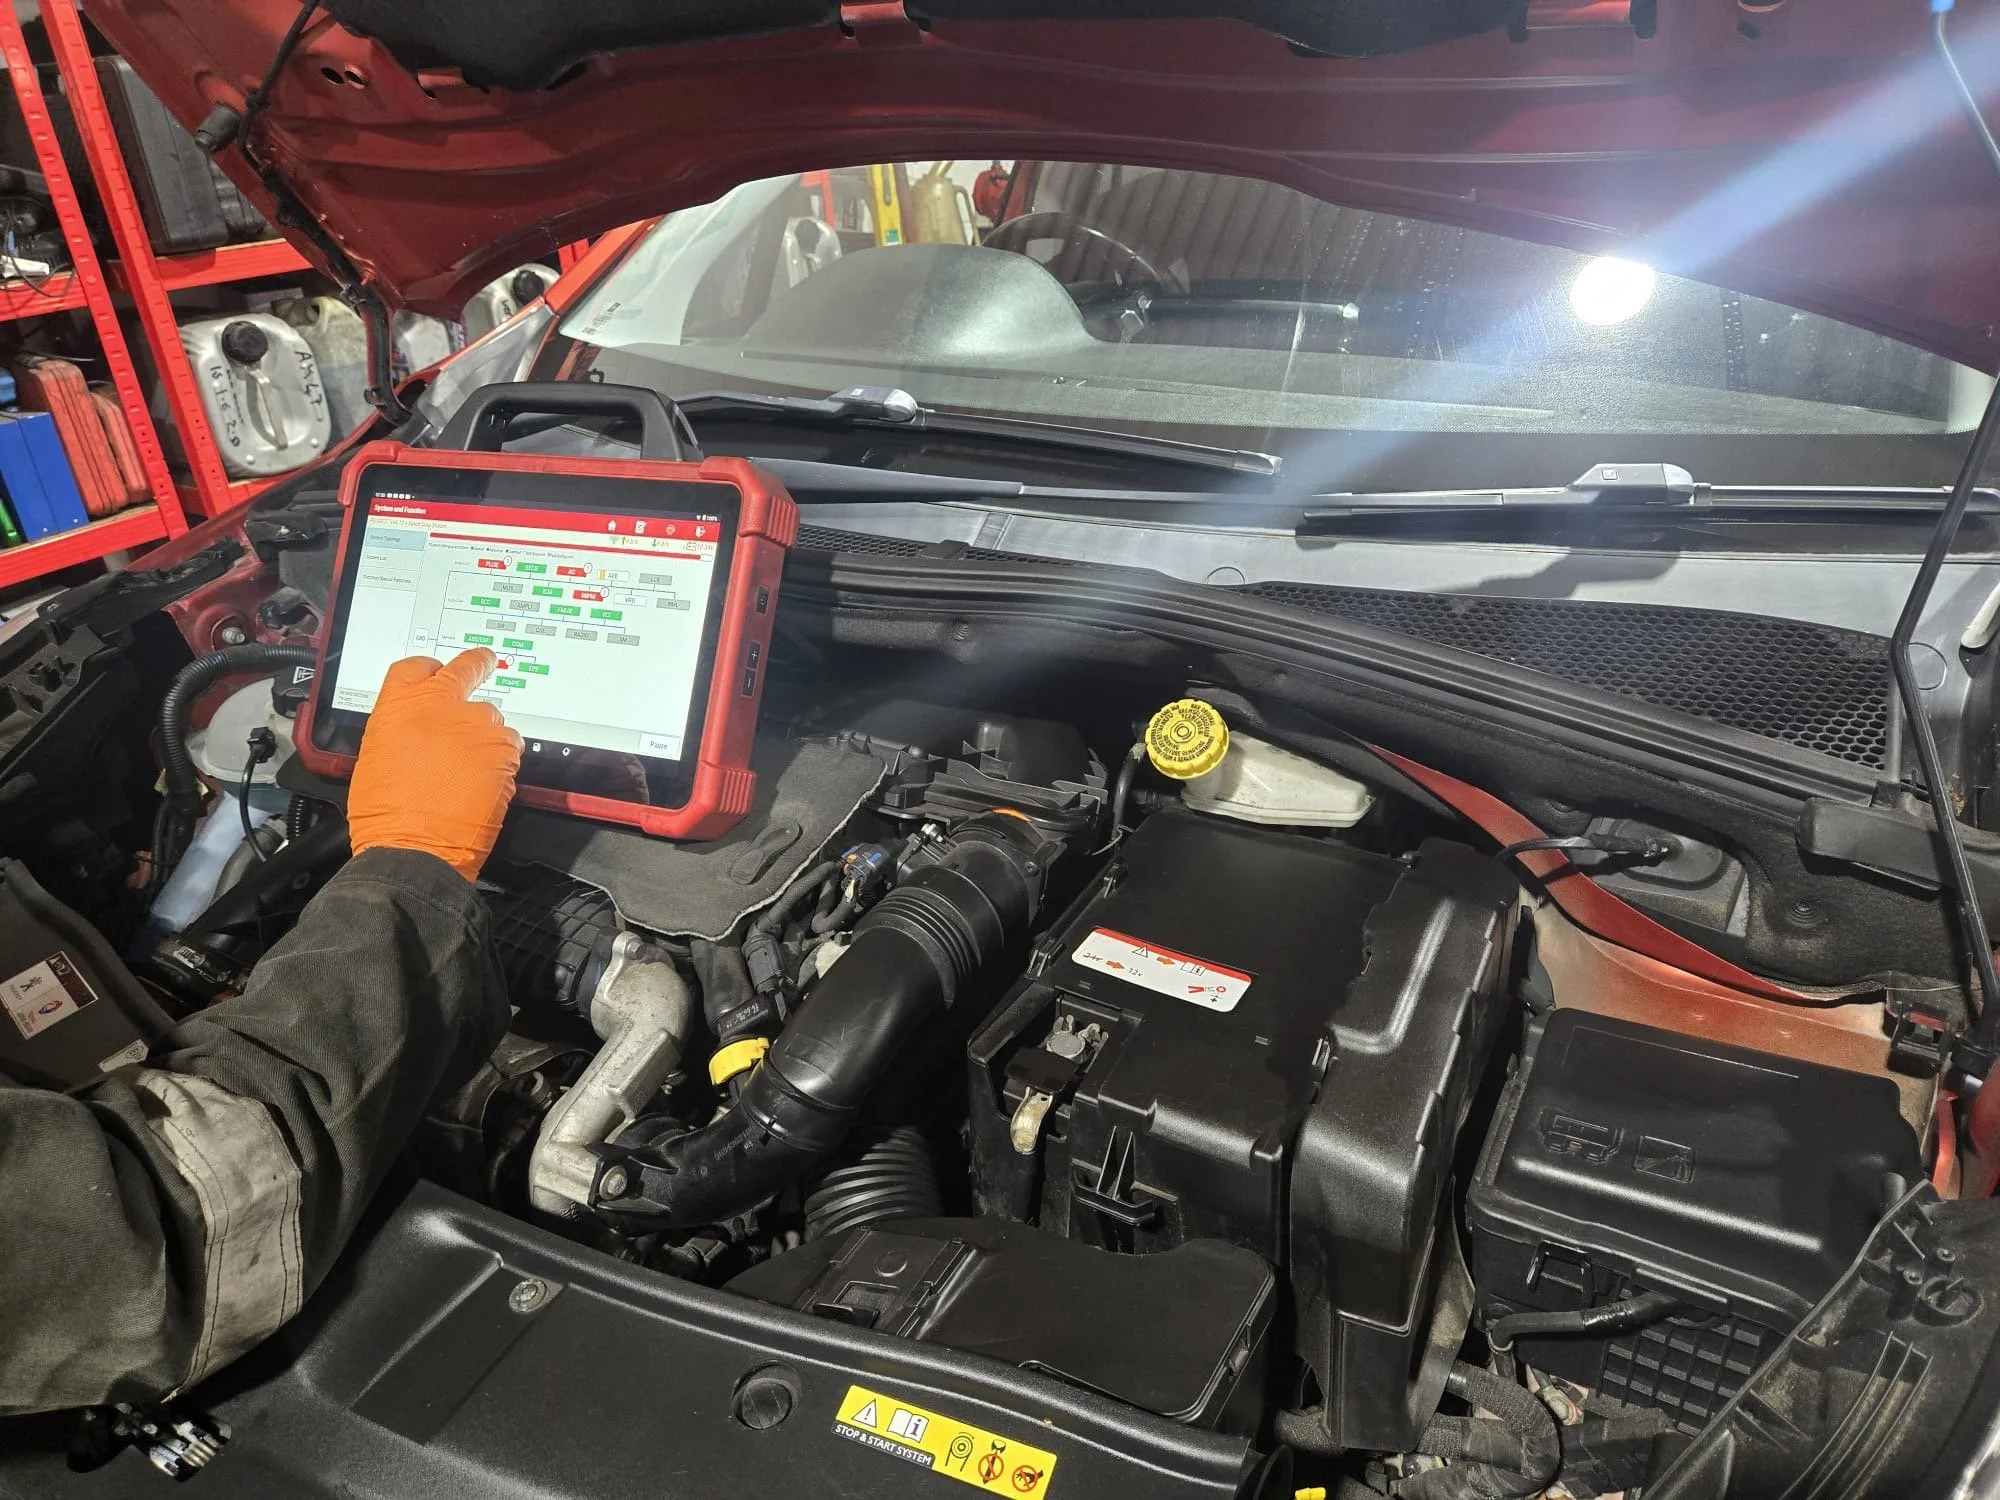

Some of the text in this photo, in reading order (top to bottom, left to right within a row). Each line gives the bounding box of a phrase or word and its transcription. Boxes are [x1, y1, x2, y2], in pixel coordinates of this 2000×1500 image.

[374, 504, 393, 513] System
[650, 740, 668, 750] Pause
[835, 1424, 933, 1466] STOP & START SYSTEM
